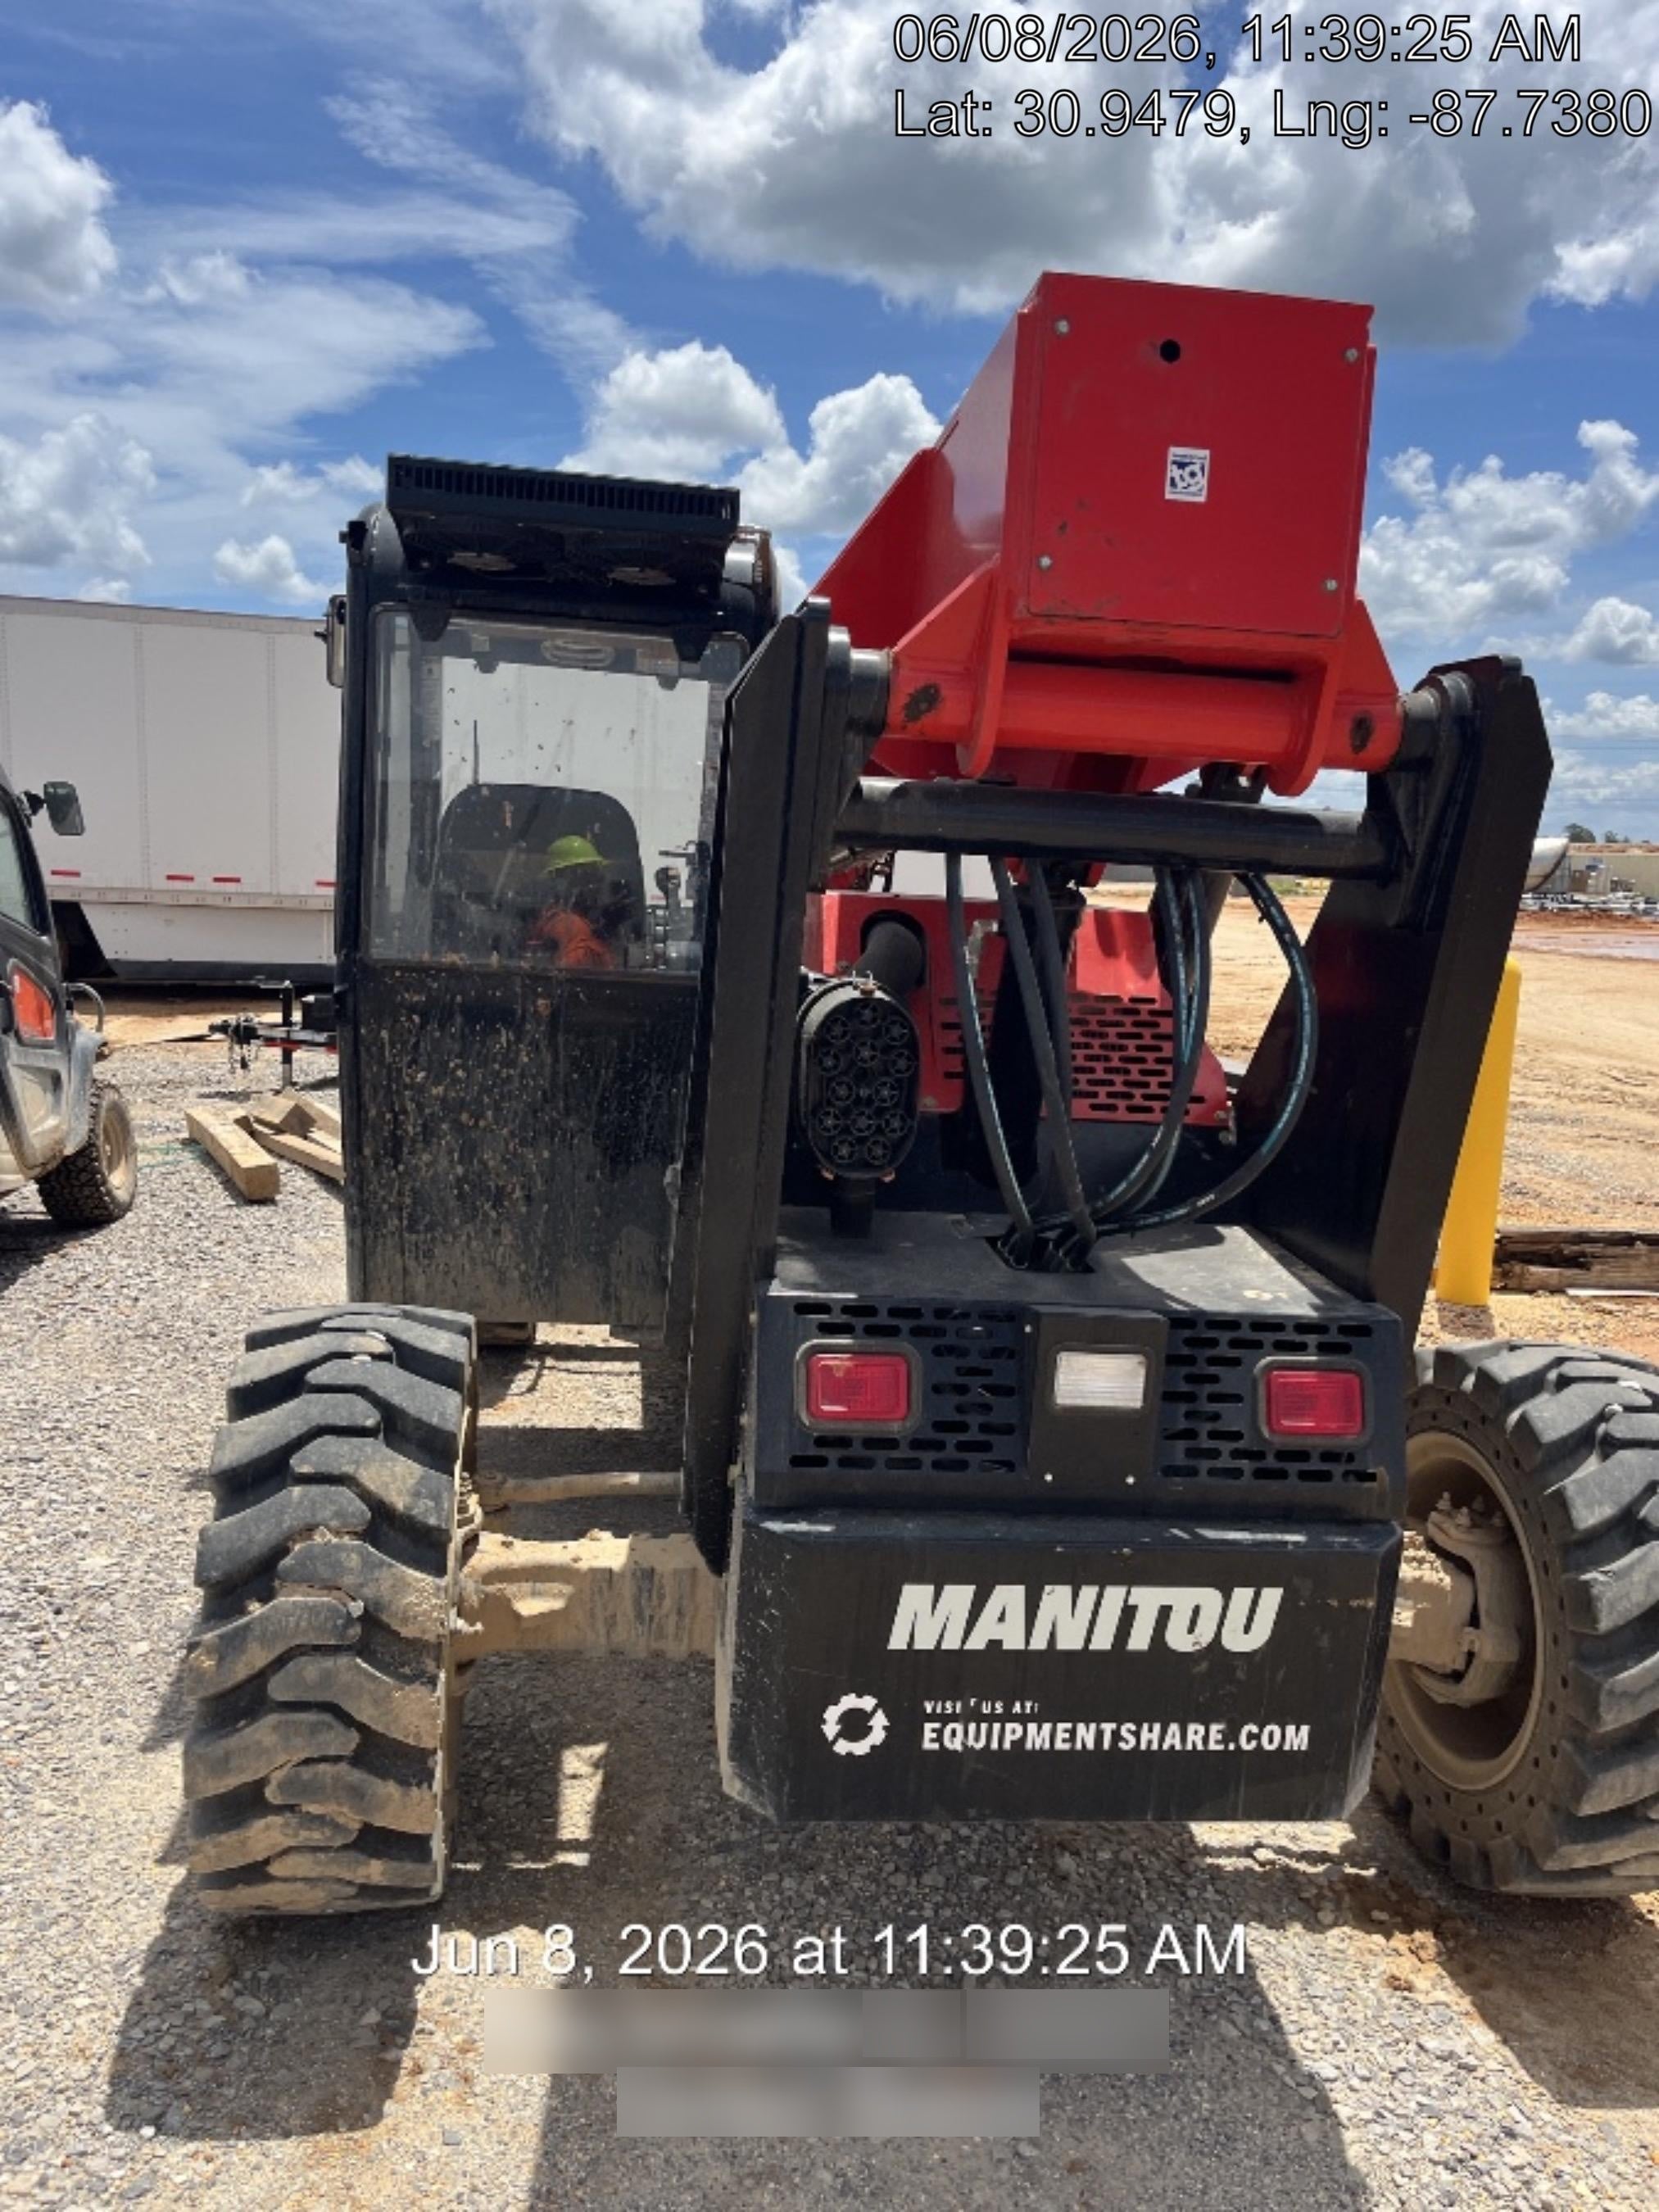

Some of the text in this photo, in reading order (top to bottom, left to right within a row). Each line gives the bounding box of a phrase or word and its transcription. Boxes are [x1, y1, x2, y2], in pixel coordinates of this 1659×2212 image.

[887, 1584, 1283, 1652] MANITOU
[981, 1700, 1003, 1714] US
[922, 1721, 1310, 1752] EQUIPMENTSHARE.COM
